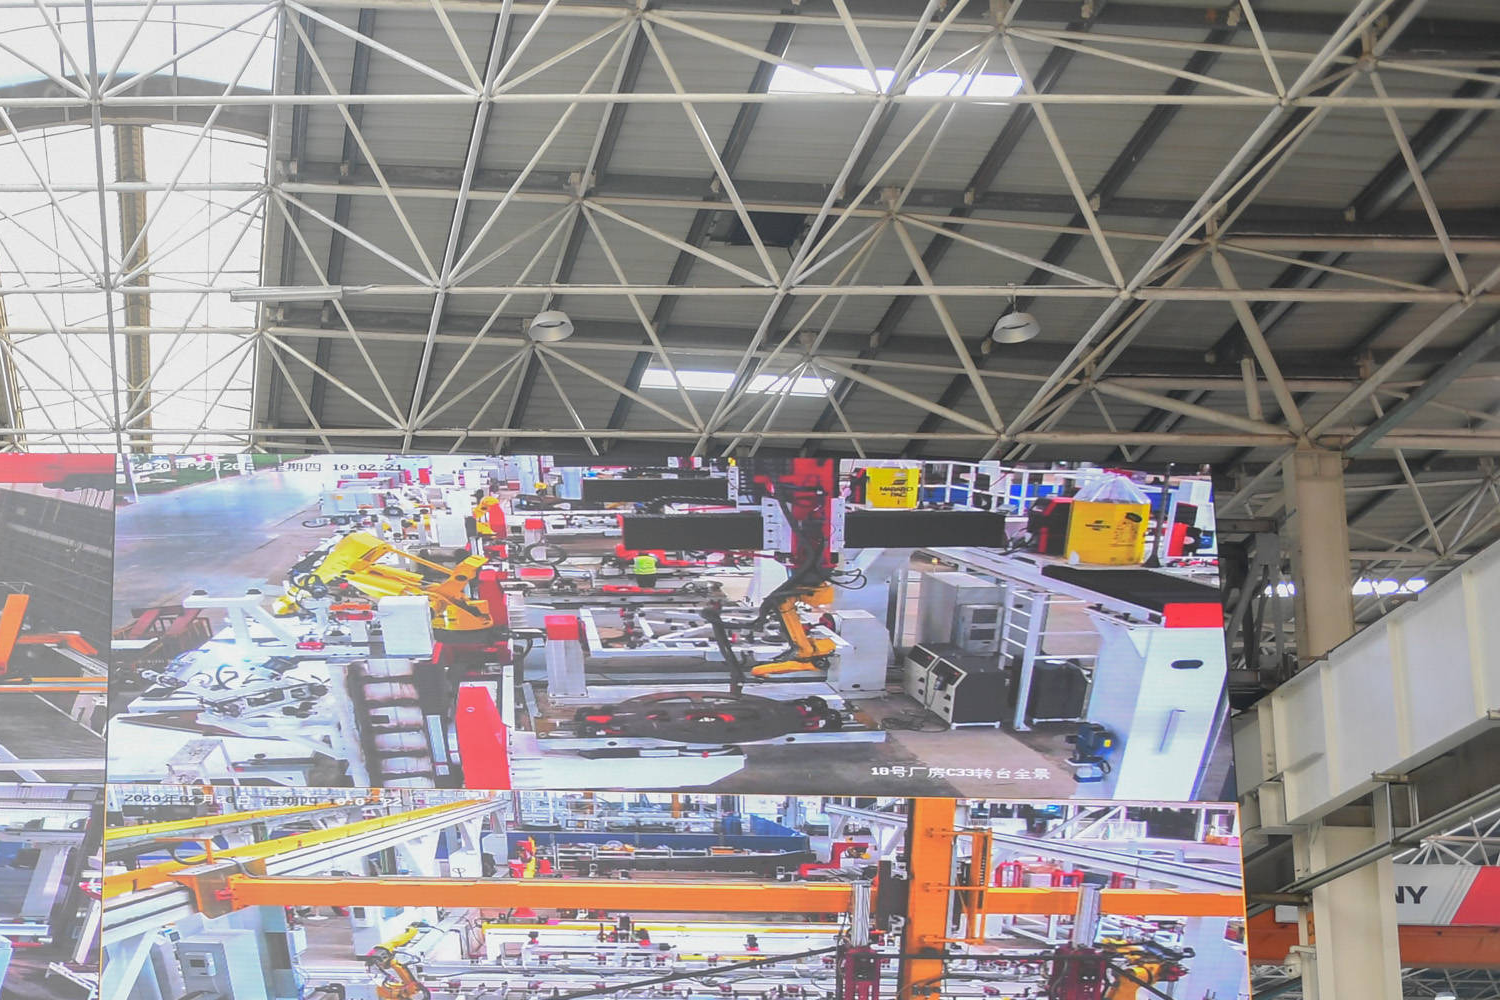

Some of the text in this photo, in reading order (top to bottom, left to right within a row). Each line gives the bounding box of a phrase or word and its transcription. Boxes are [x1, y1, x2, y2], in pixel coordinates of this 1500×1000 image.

[333, 463, 403, 472] 10:02:21
[871, 766, 1050, 780] 18号厂房C33转台全景
